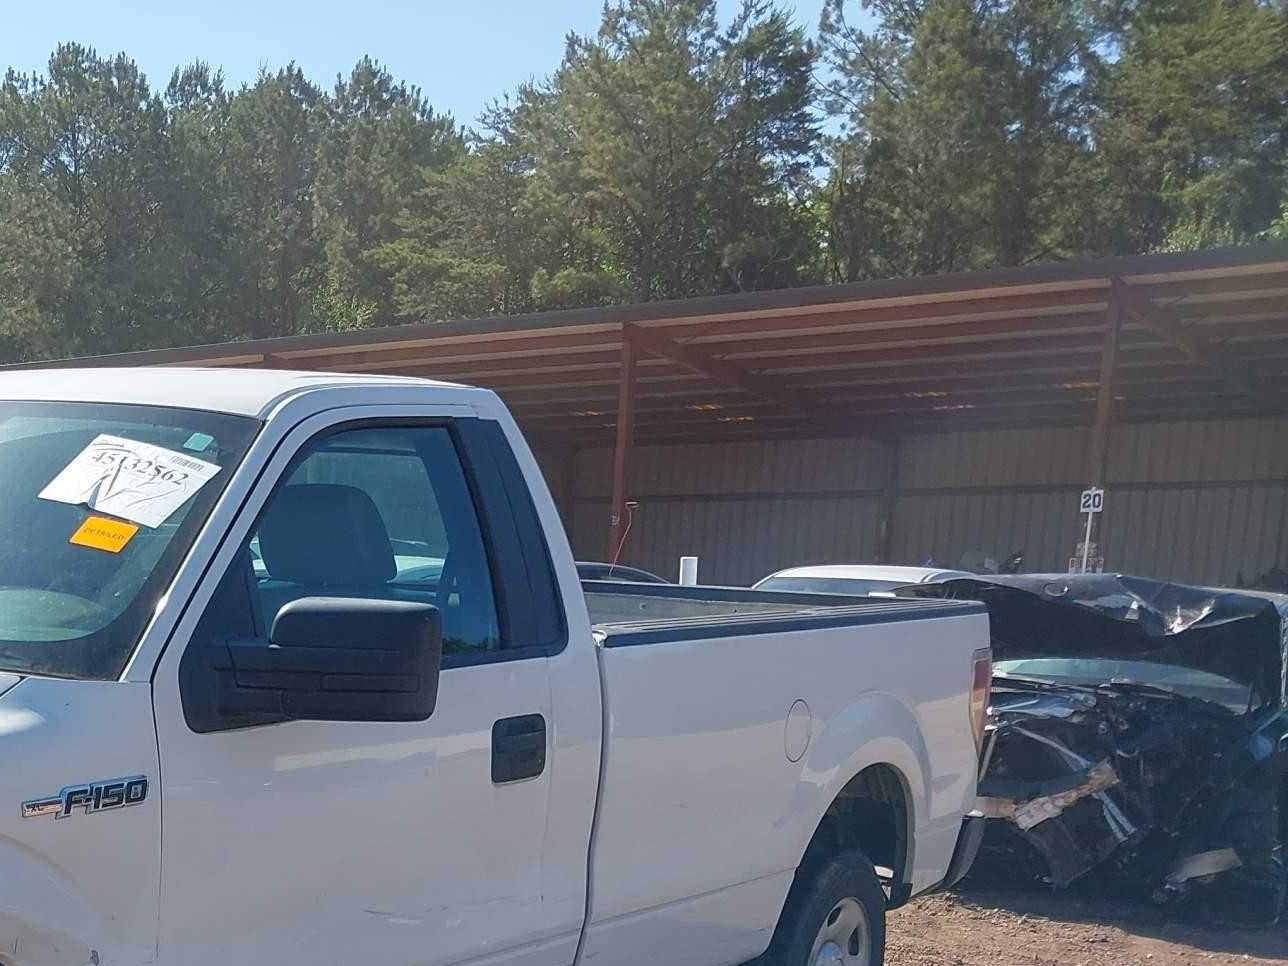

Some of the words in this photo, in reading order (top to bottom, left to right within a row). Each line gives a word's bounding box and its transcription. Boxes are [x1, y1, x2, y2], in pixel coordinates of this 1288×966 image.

[1082, 493, 1102, 509] 20
[83, 526, 126, 542] DETAILED
[63, 778, 148, 815] F-150
